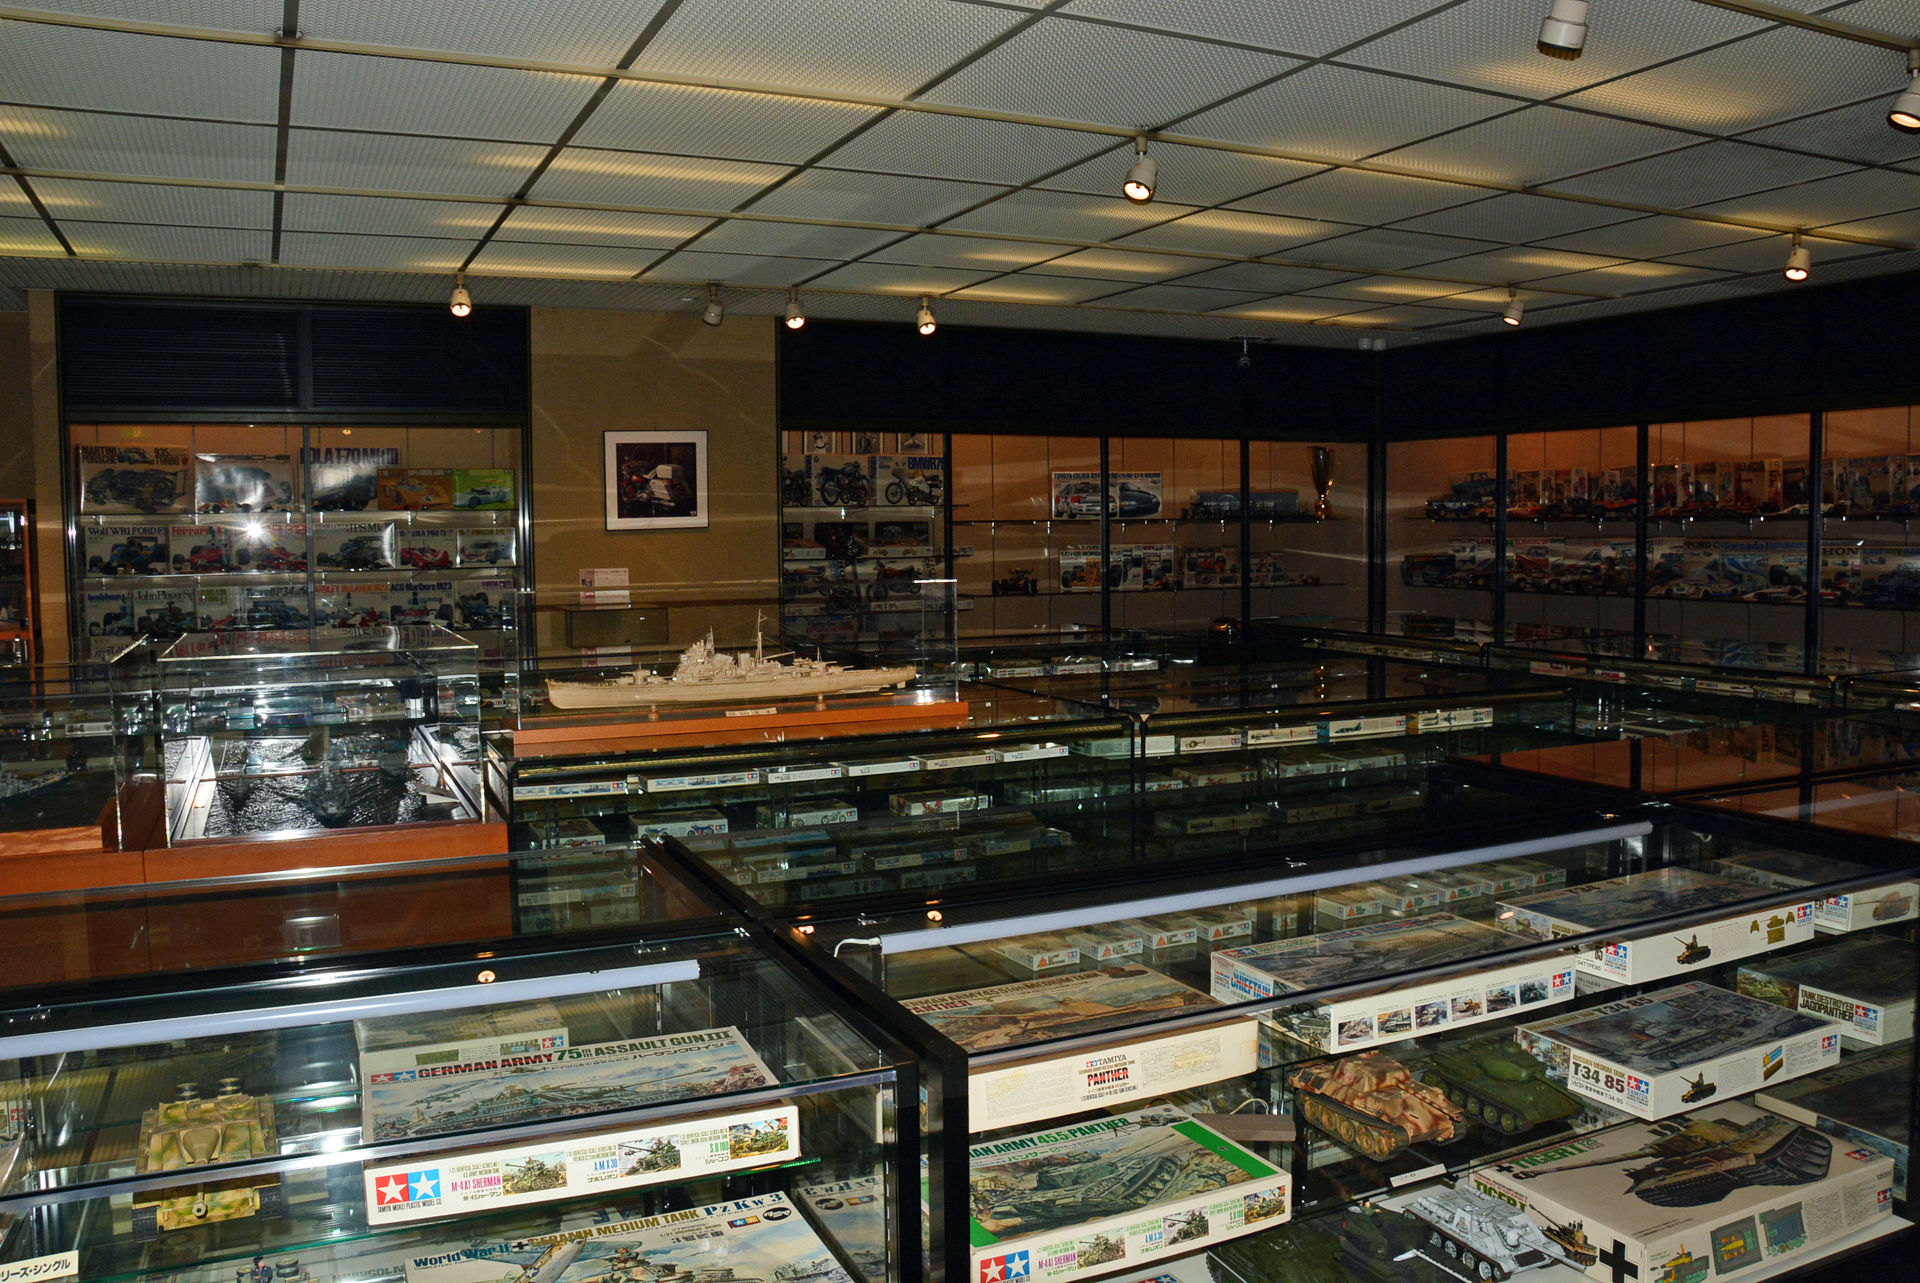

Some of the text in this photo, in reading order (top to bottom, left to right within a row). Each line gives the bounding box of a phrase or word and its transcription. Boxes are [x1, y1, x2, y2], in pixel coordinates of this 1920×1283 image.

[82, 446, 117, 455] MARTINI
[154, 447, 170, 455] 935
[82, 455, 117, 464] PORSCHE
[154, 456, 180, 465] TURBO
[87, 526, 109, 535] Wolf
[132, 526, 156, 535] FORD
[172, 525, 209, 535] Ferrari
[1687, 541, 1712, 549] FORD
[1723, 541, 1764, 550] Tornado
[275, 587, 294, 596] P34
[405, 581, 452, 592] Marlboro M23
[135, 590, 154, 601] John
[1826, 904, 1849, 915] TAMIYA
[1605, 955, 1628, 965] TAMIYA
[1026, 977, 1074, 991] MEDIUM
[1074, 972, 1103, 984] TANK
[1552, 985, 1572, 995] TAMIYA
[1800, 989, 1855, 1012] TANK DESTROYER
[1855, 1016, 1878, 1027] TAMIYA
[418, 1060, 498, 1078] GERMAN
[501, 1053, 554, 1068] ARMY
[594, 1039, 667, 1056] ASSAULT
[669, 1034, 705, 1046] GUN
[1098, 1054, 1128, 1066] TAMIYA
[1572, 1053, 1626, 1079] RUSSIAN MEDIUM TANK
[1087, 1067, 1129, 1087] PANTHER
[1604, 1074, 1625, 1093] 85
[1626, 1087, 1649, 1100] TAMIYA
[993, 1137, 1039, 1155] ARMY
[1069, 1117, 1130, 1139] PANTHER
[719, 1141, 729, 1151] 100
[1508, 1147, 1576, 1169] TIGER
[472, 1175, 501, 1189] SHERMAN
[587, 1173, 618, 1183] ナポレオン
[377, 1204, 392, 1213] TAMIYA
[406, 1200, 421, 1210] PLASTIC
[422, 1199, 435, 1208] MODEL
[413, 1250, 461, 1268] World
[462, 1246, 496, 1259] War
[531, 1228, 594, 1248] GERAMN
[597, 1216, 660, 1238] MEDIUM
[662, 1208, 700, 1225] TANK
[769, 1193, 783, 1203] 3
[1054, 1252, 1076, 1266] SHERMAN
